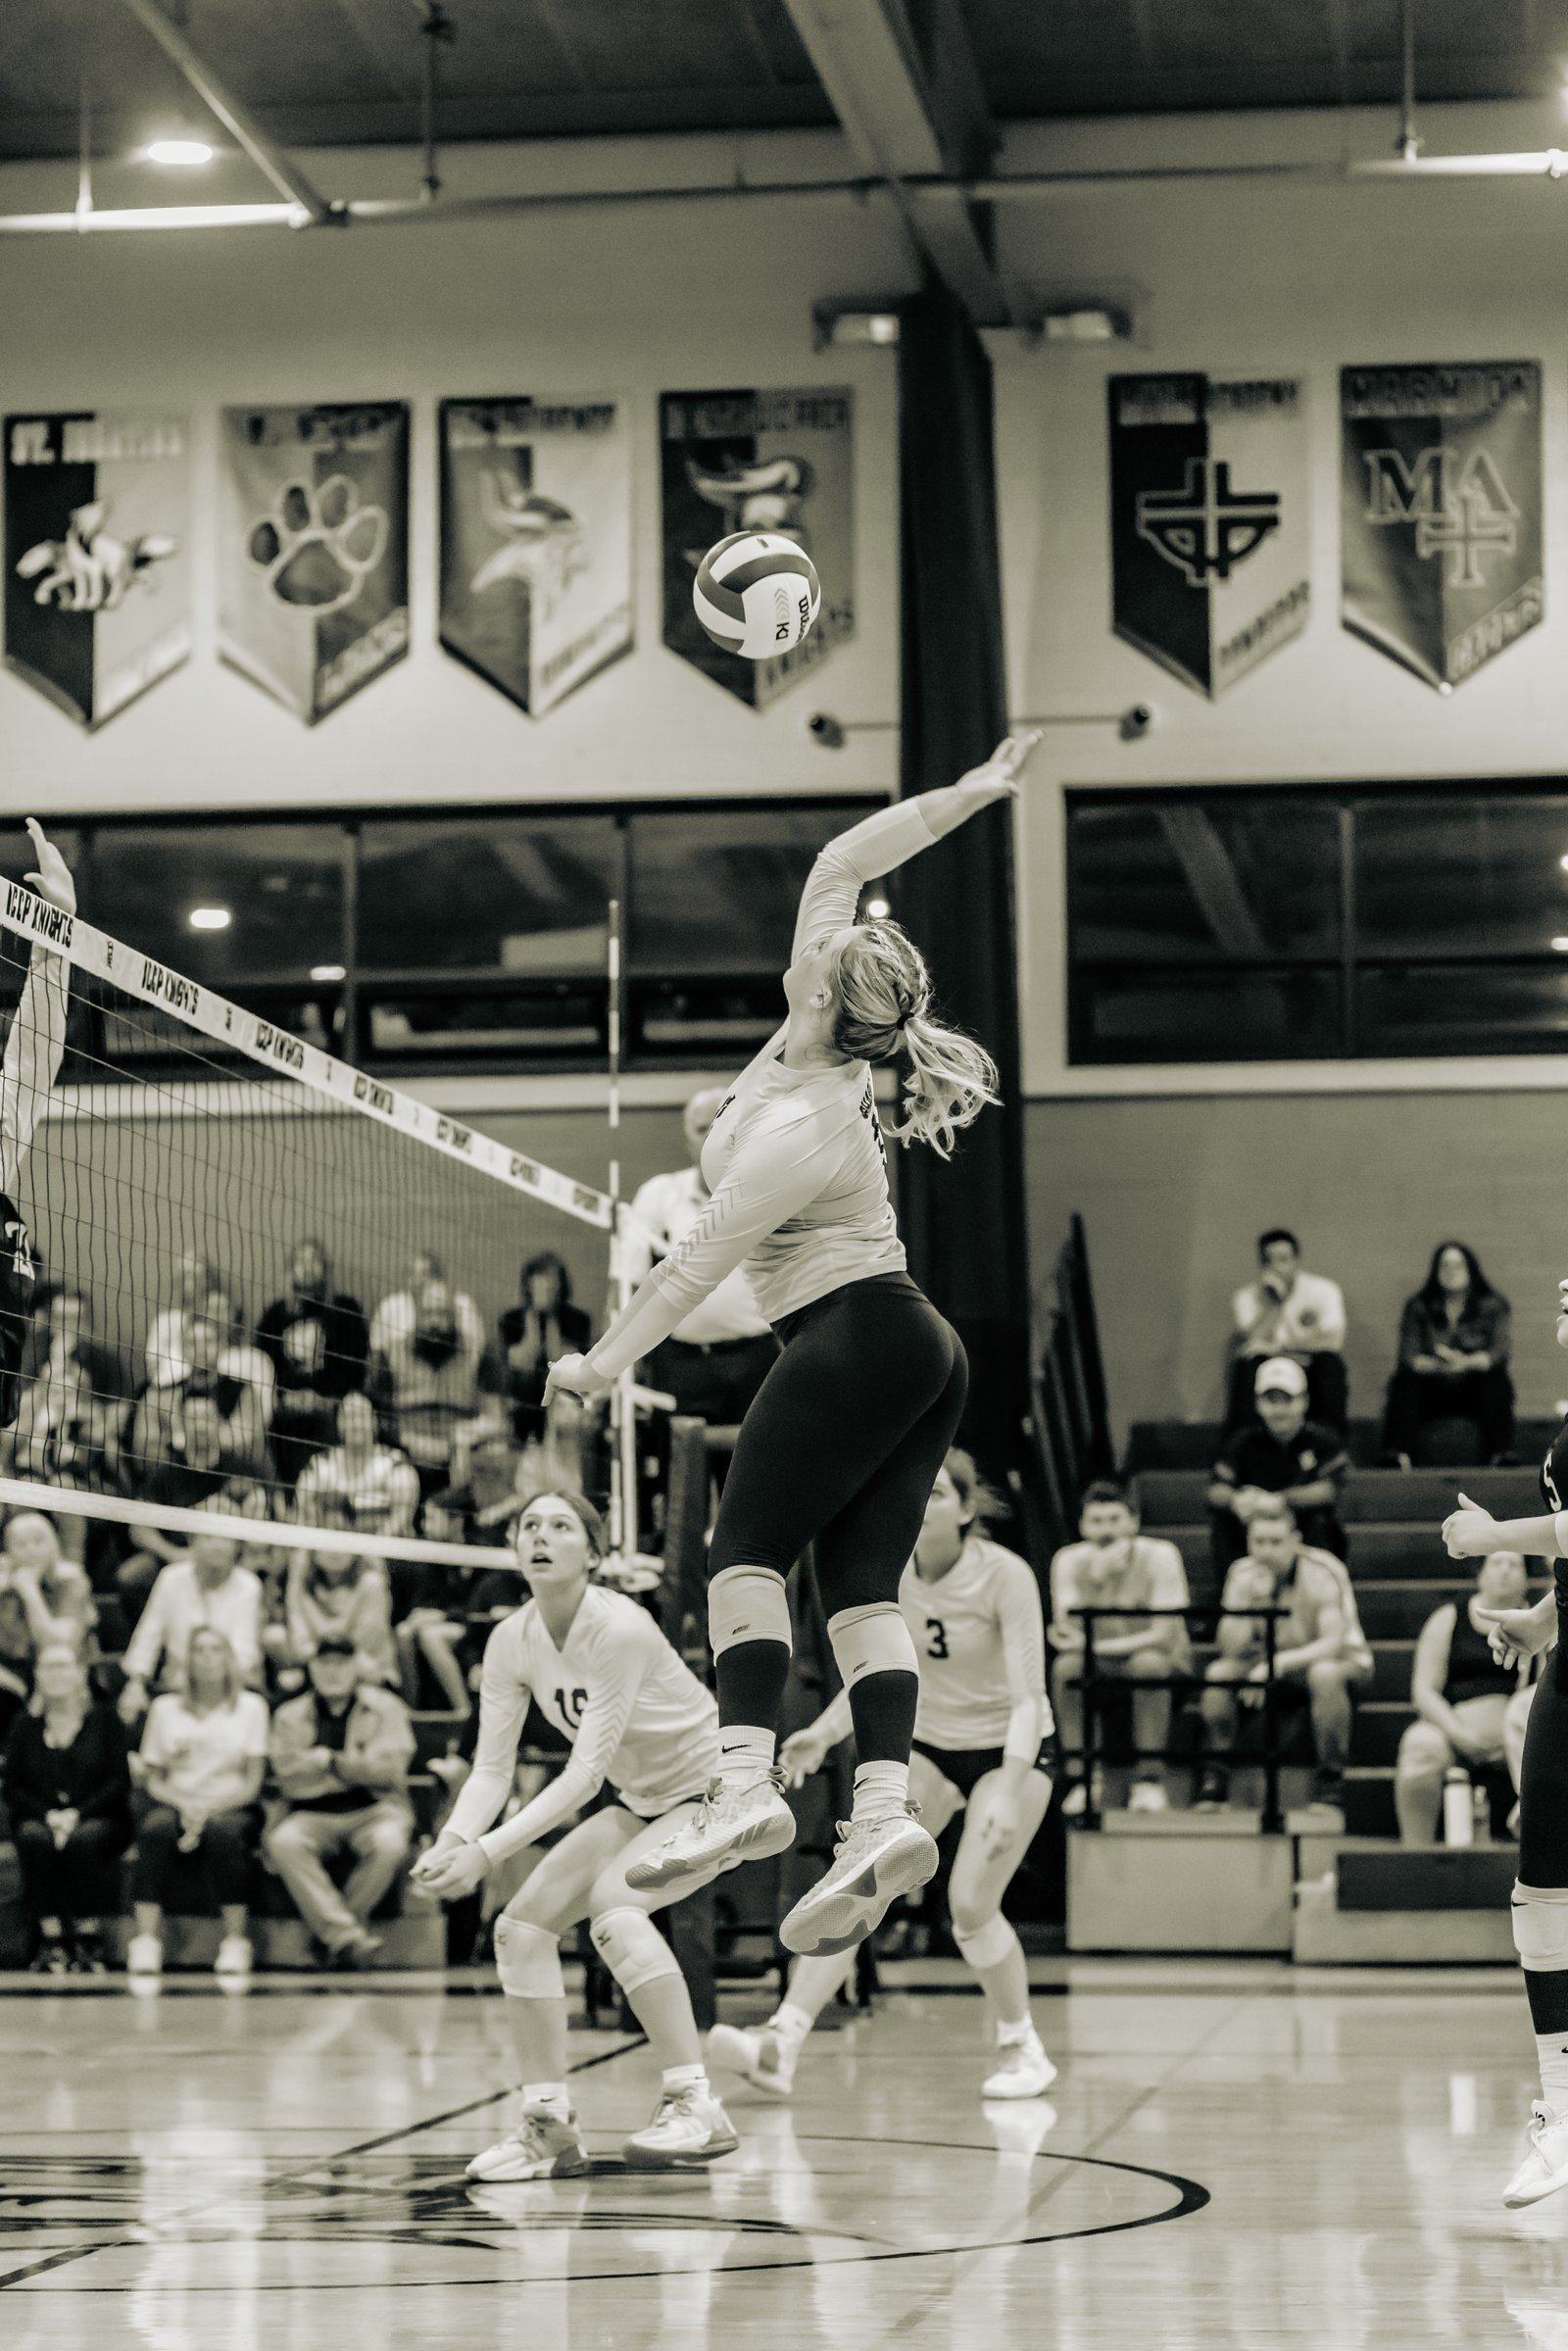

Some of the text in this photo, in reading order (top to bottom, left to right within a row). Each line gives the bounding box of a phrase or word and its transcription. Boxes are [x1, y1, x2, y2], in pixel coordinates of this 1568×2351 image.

[6, 883, 74, 949] ICCP KNIGHTS
[925, 1618, 949, 1659] 3
